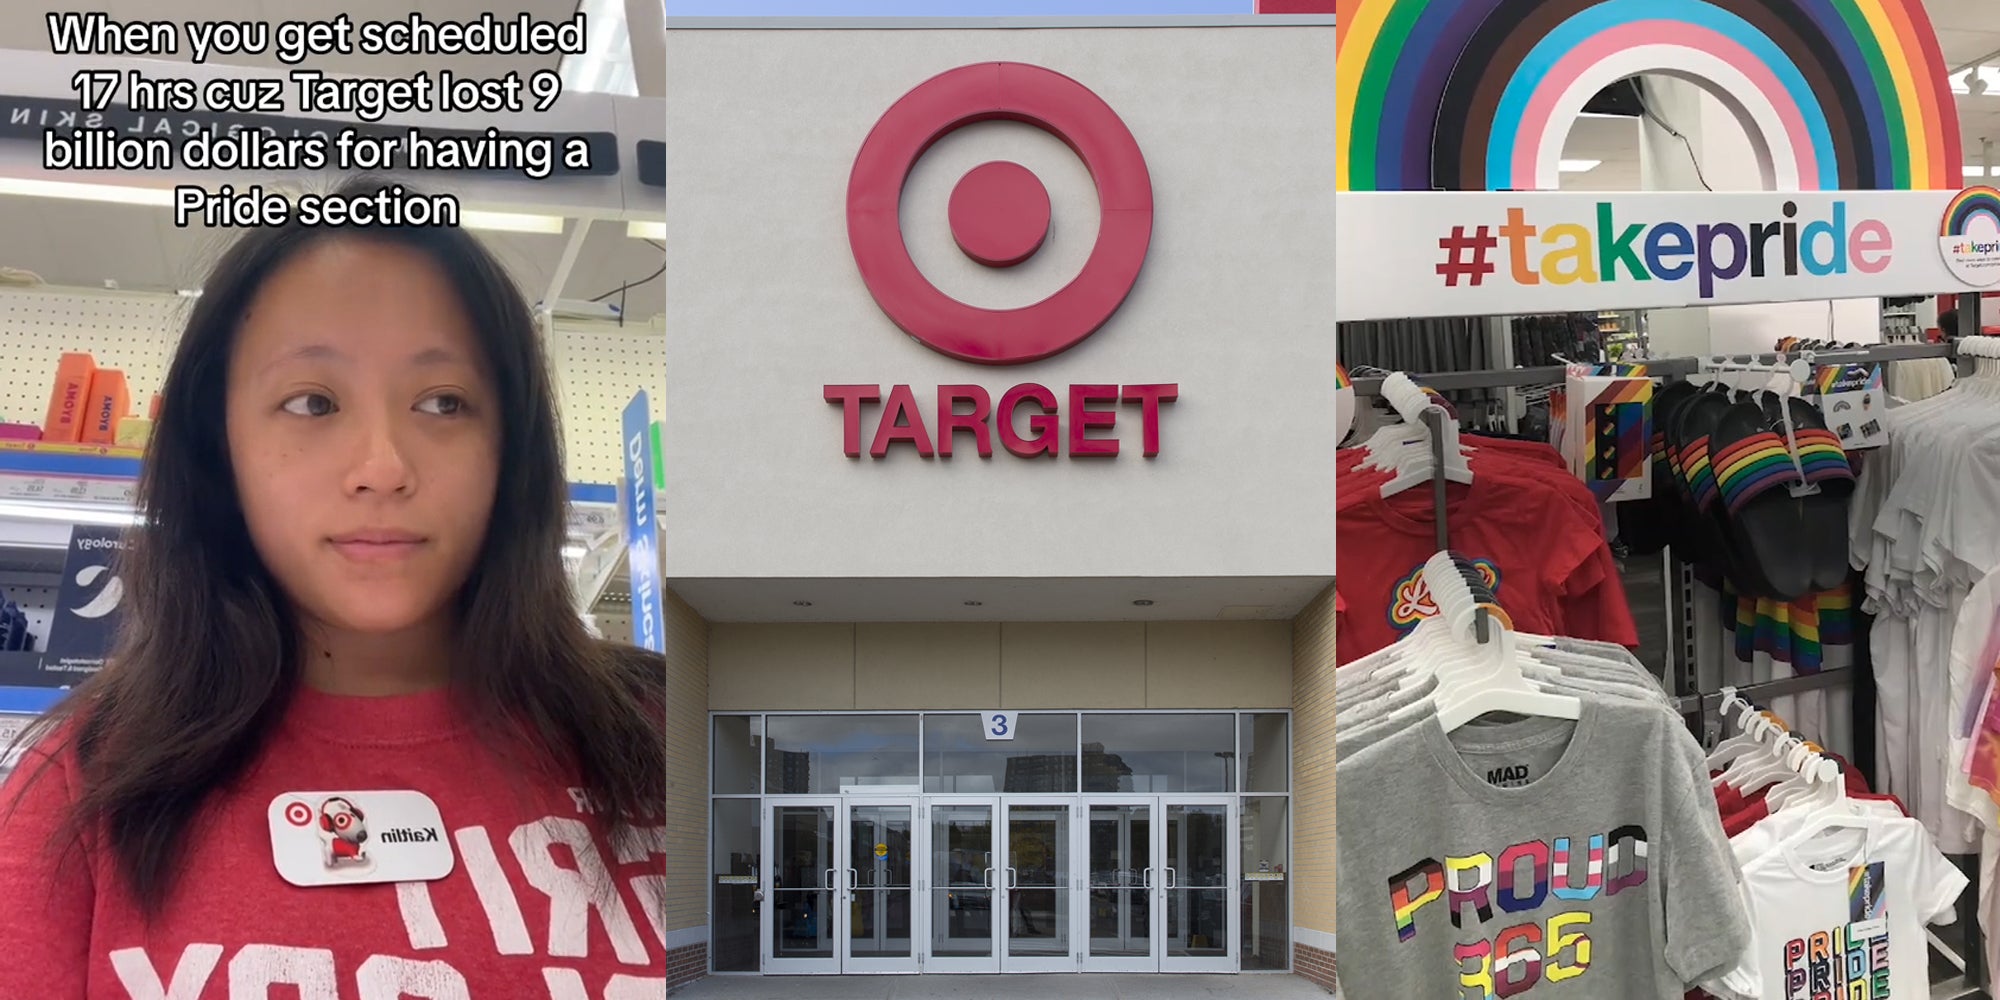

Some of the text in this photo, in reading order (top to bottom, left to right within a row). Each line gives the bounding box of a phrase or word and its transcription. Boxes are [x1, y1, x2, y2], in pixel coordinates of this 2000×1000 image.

[1435, 201, 1893, 298] #takepride
[1953, 240, 2000, 255] #takepri
[823, 383, 1179, 458] TARGET
[991, 714, 1008, 736] 3
[1487, 765, 1529, 785] MAD
[1388, 825, 1648, 943] PROUD
[1454, 910, 1592, 1000] 365
[1784, 918, 1888, 971] PRI
[1785, 942, 1889, 999] PRIDE
